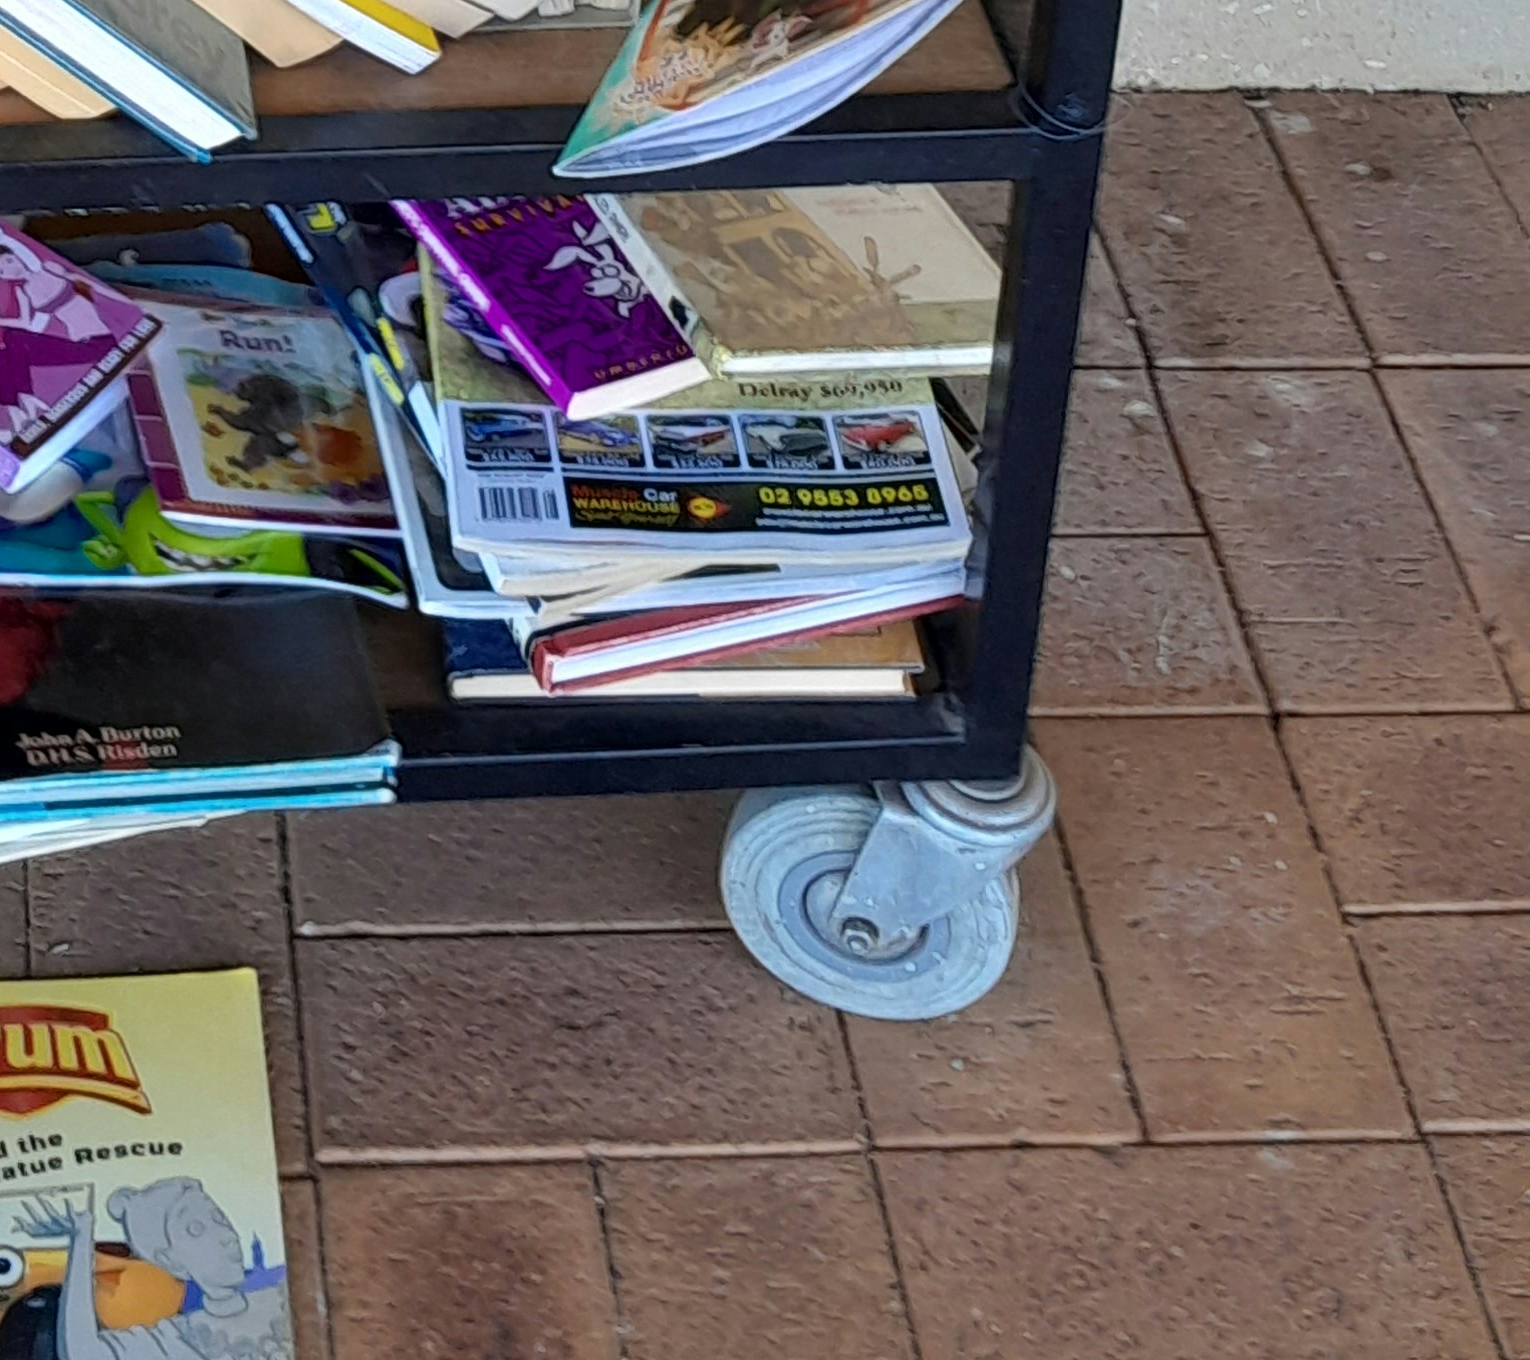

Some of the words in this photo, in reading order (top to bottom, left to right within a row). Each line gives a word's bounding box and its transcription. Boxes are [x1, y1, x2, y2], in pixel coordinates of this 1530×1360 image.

[219, 328, 295, 354] Run!
[737, 381, 813, 402] Delray
[573, 497, 680, 514] WAREHOUSE
[643, 487, 678, 502] Car
[759, 486, 790, 505] 02
[15, 731, 74, 750] John
[101, 723, 182, 745] Burton
[98, 740, 179, 762] Risden
[16, 1131, 65, 1156] the
[74, 1139, 185, 1167] Rescue
